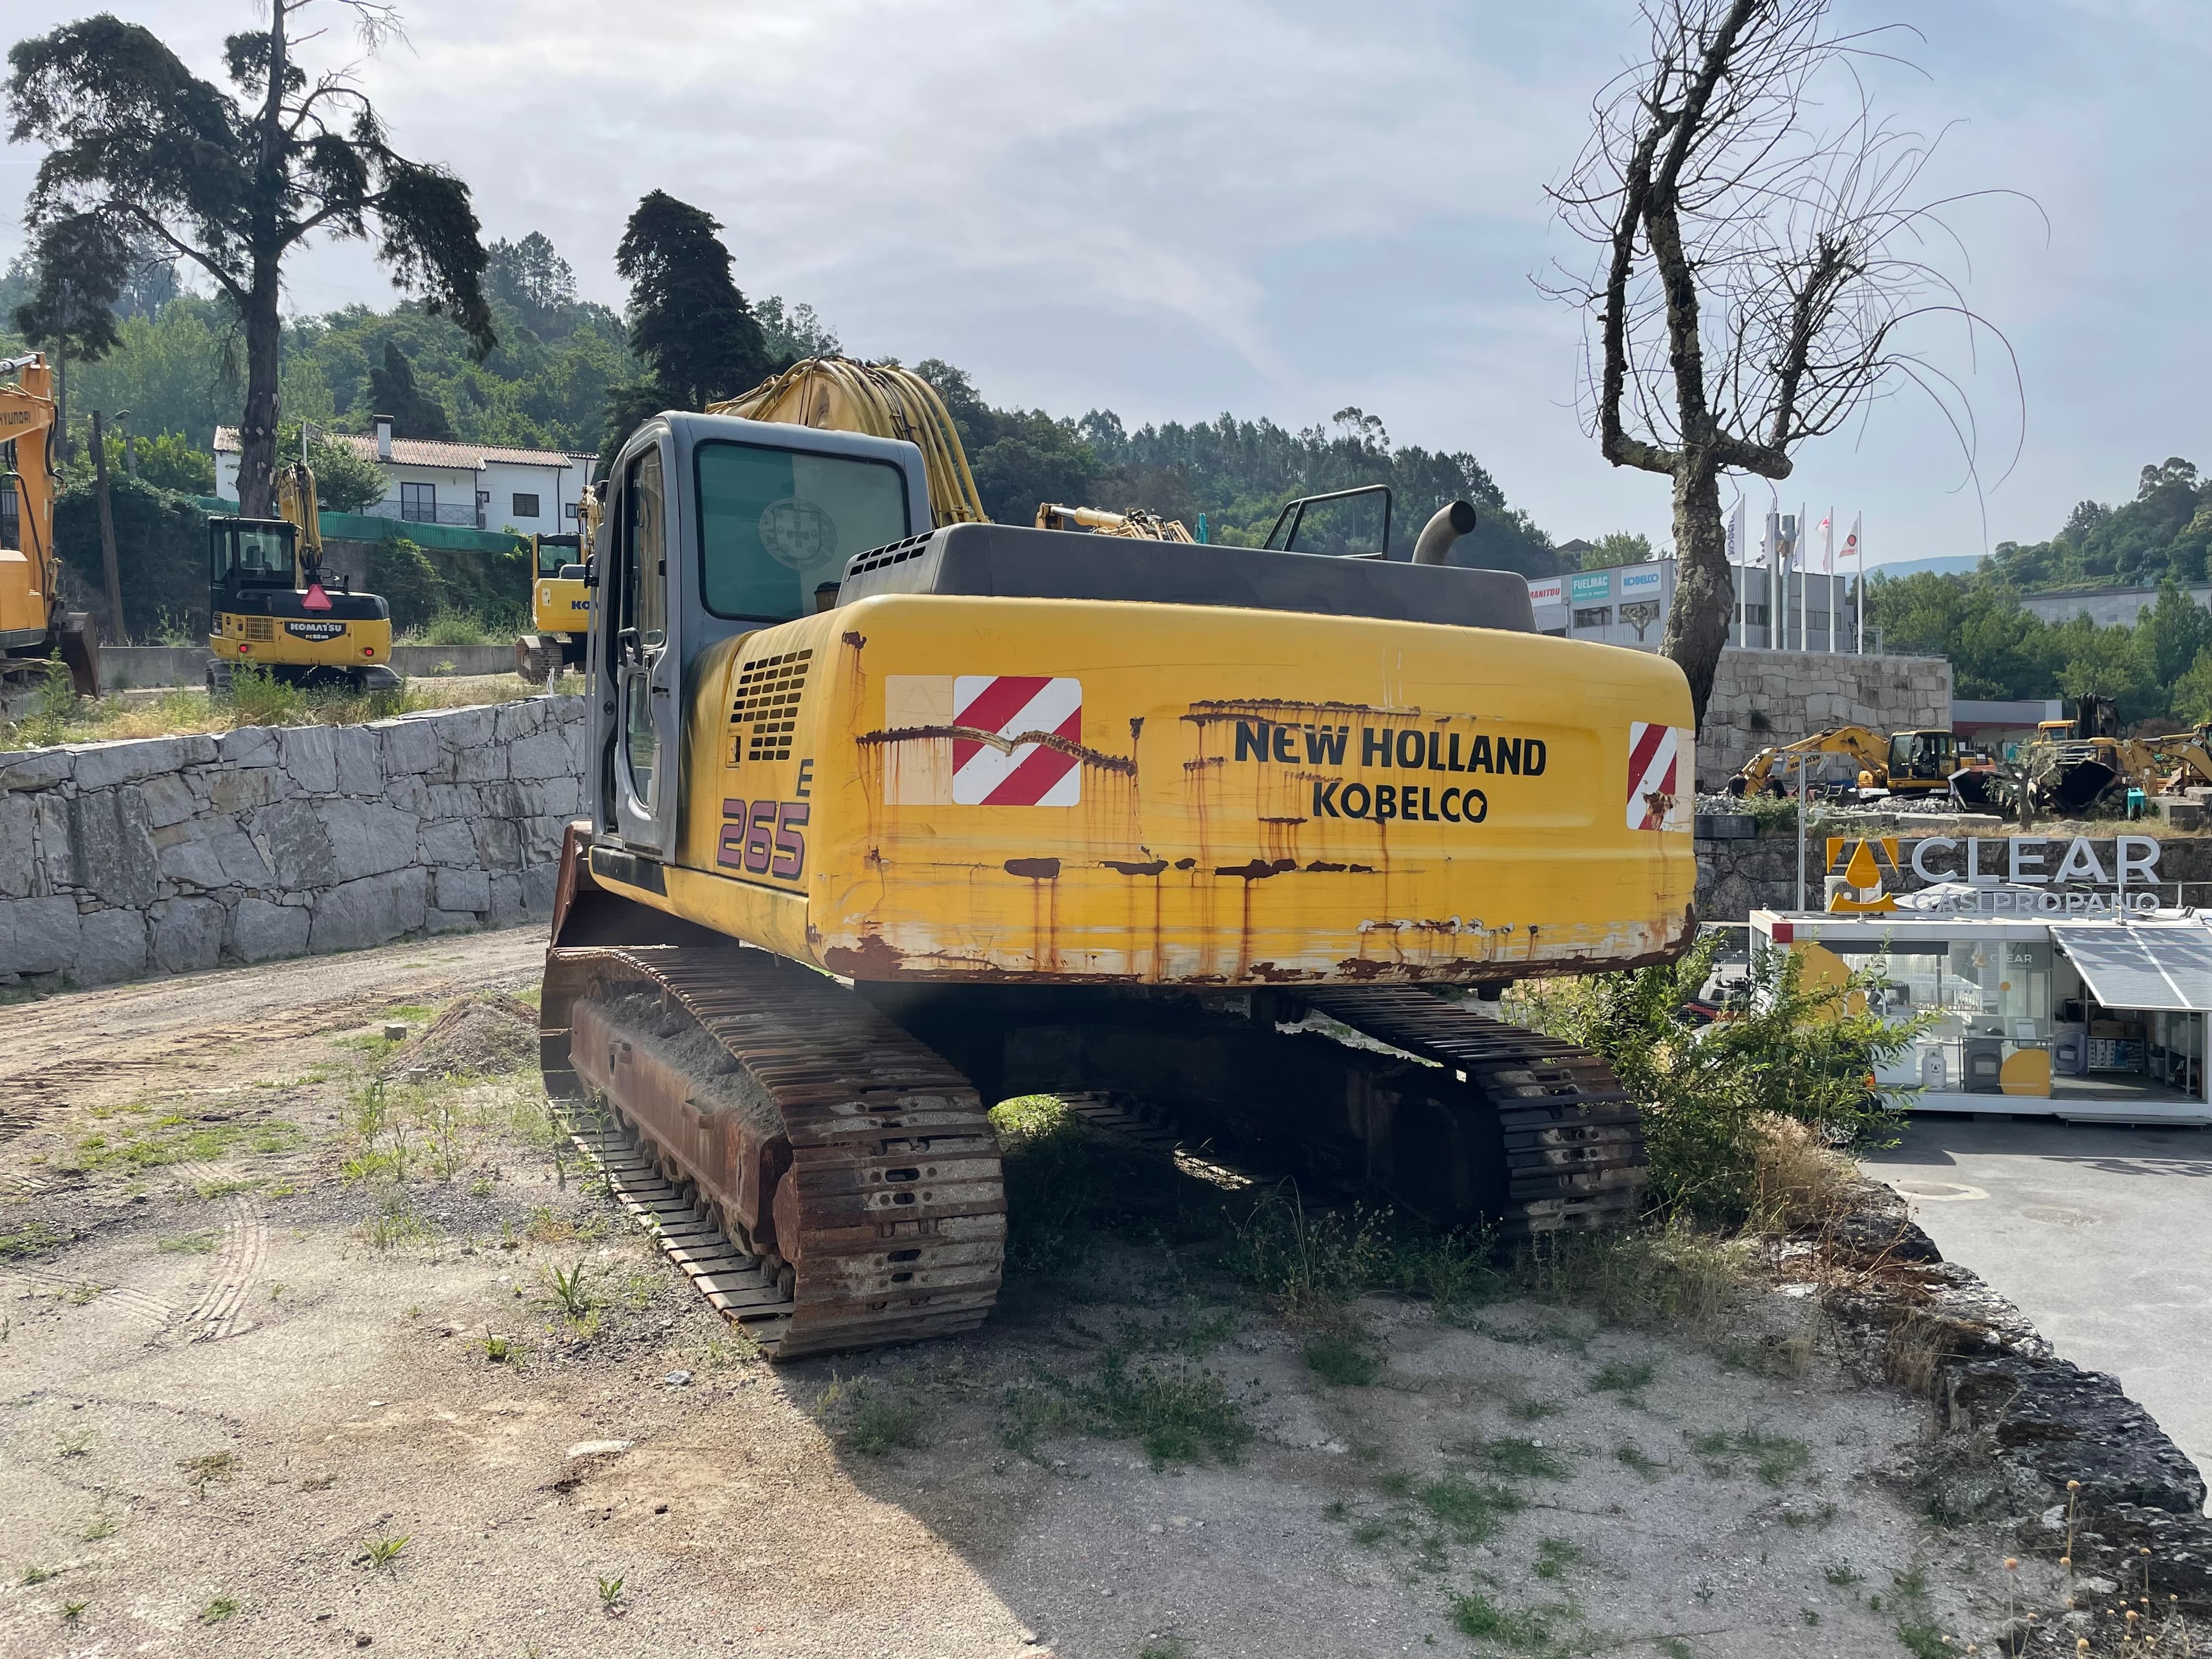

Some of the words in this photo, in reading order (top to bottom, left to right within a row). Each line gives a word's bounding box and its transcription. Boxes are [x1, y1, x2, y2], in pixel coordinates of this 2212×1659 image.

[1573, 577, 1608, 590] FUELMAC
[1623, 574, 1658, 587] KOBELCO
[290, 623, 342, 632] KOMATSU
[1234, 721, 1349, 765] NEW
[1361, 728, 1547, 776] HOLLAND
[796, 759, 813, 797] E
[1313, 782, 1487, 823] KOBELCO
[717, 798, 810, 881] 265
[1912, 836, 2161, 883] CLEAR
[1993, 892, 2160, 914] PROPANO
[1990, 954, 2033, 963] CEAR
